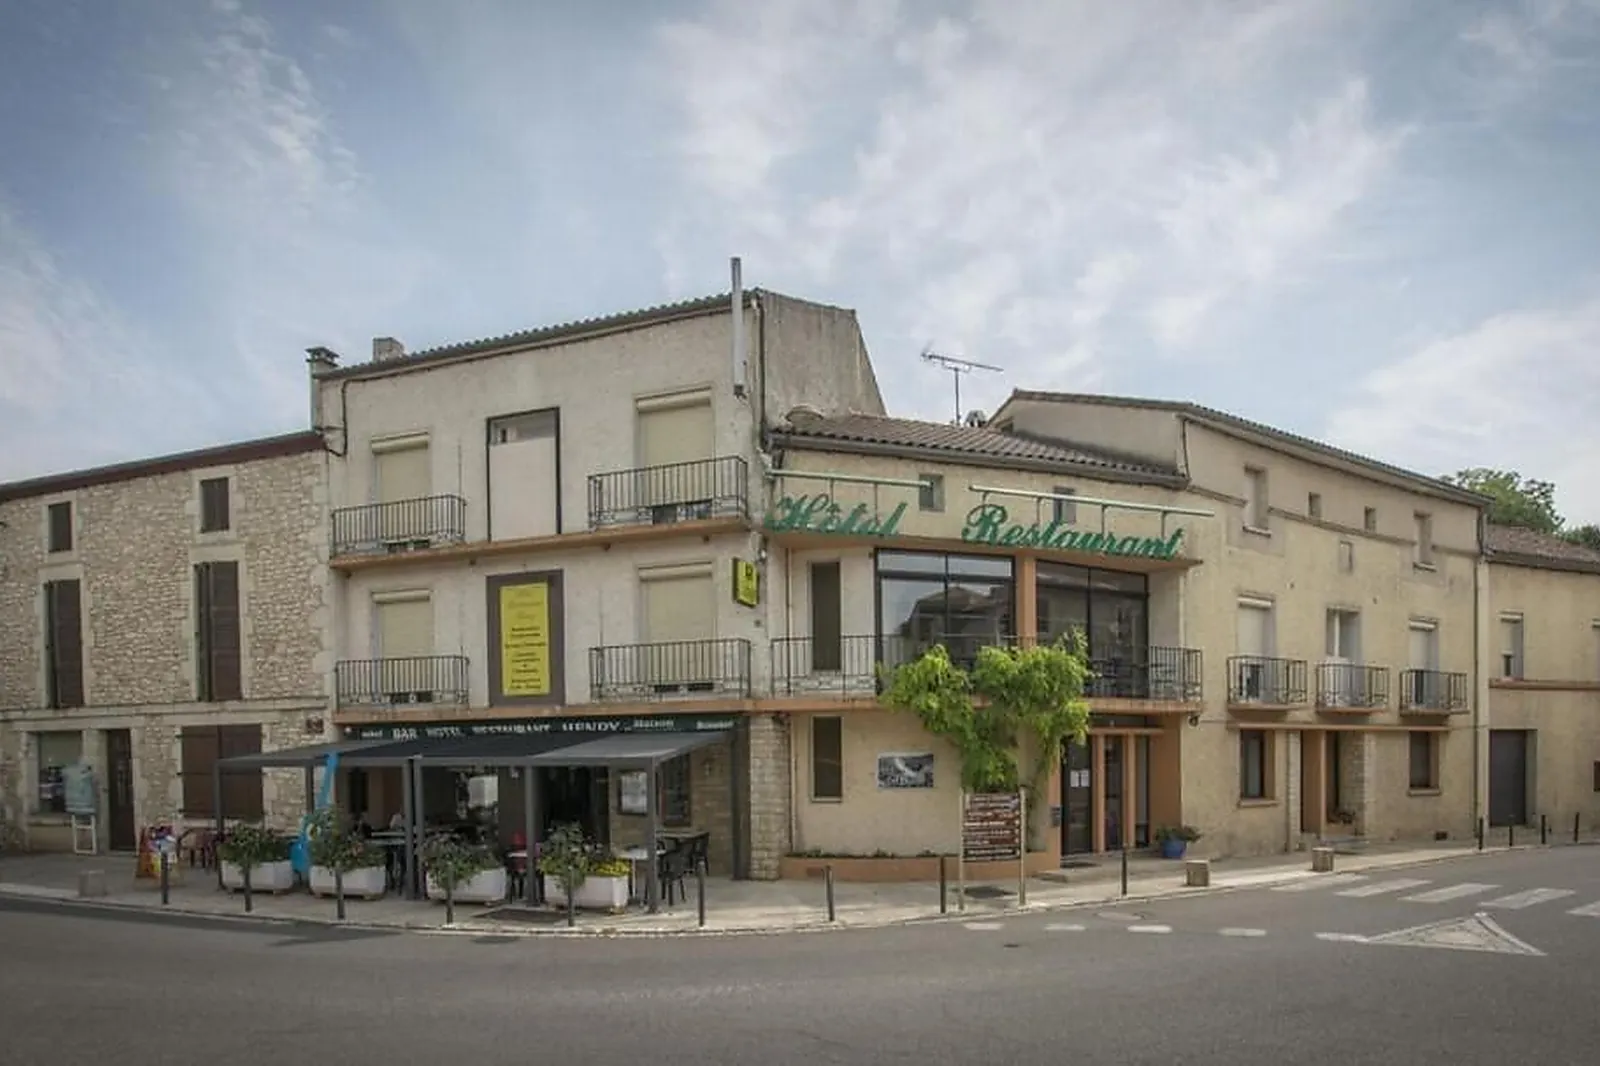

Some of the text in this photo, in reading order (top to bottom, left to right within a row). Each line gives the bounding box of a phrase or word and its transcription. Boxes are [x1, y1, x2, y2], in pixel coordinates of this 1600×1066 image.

[764, 493, 1183, 561] Hôtel Restaurant
[392, 727, 418, 741] BAR
